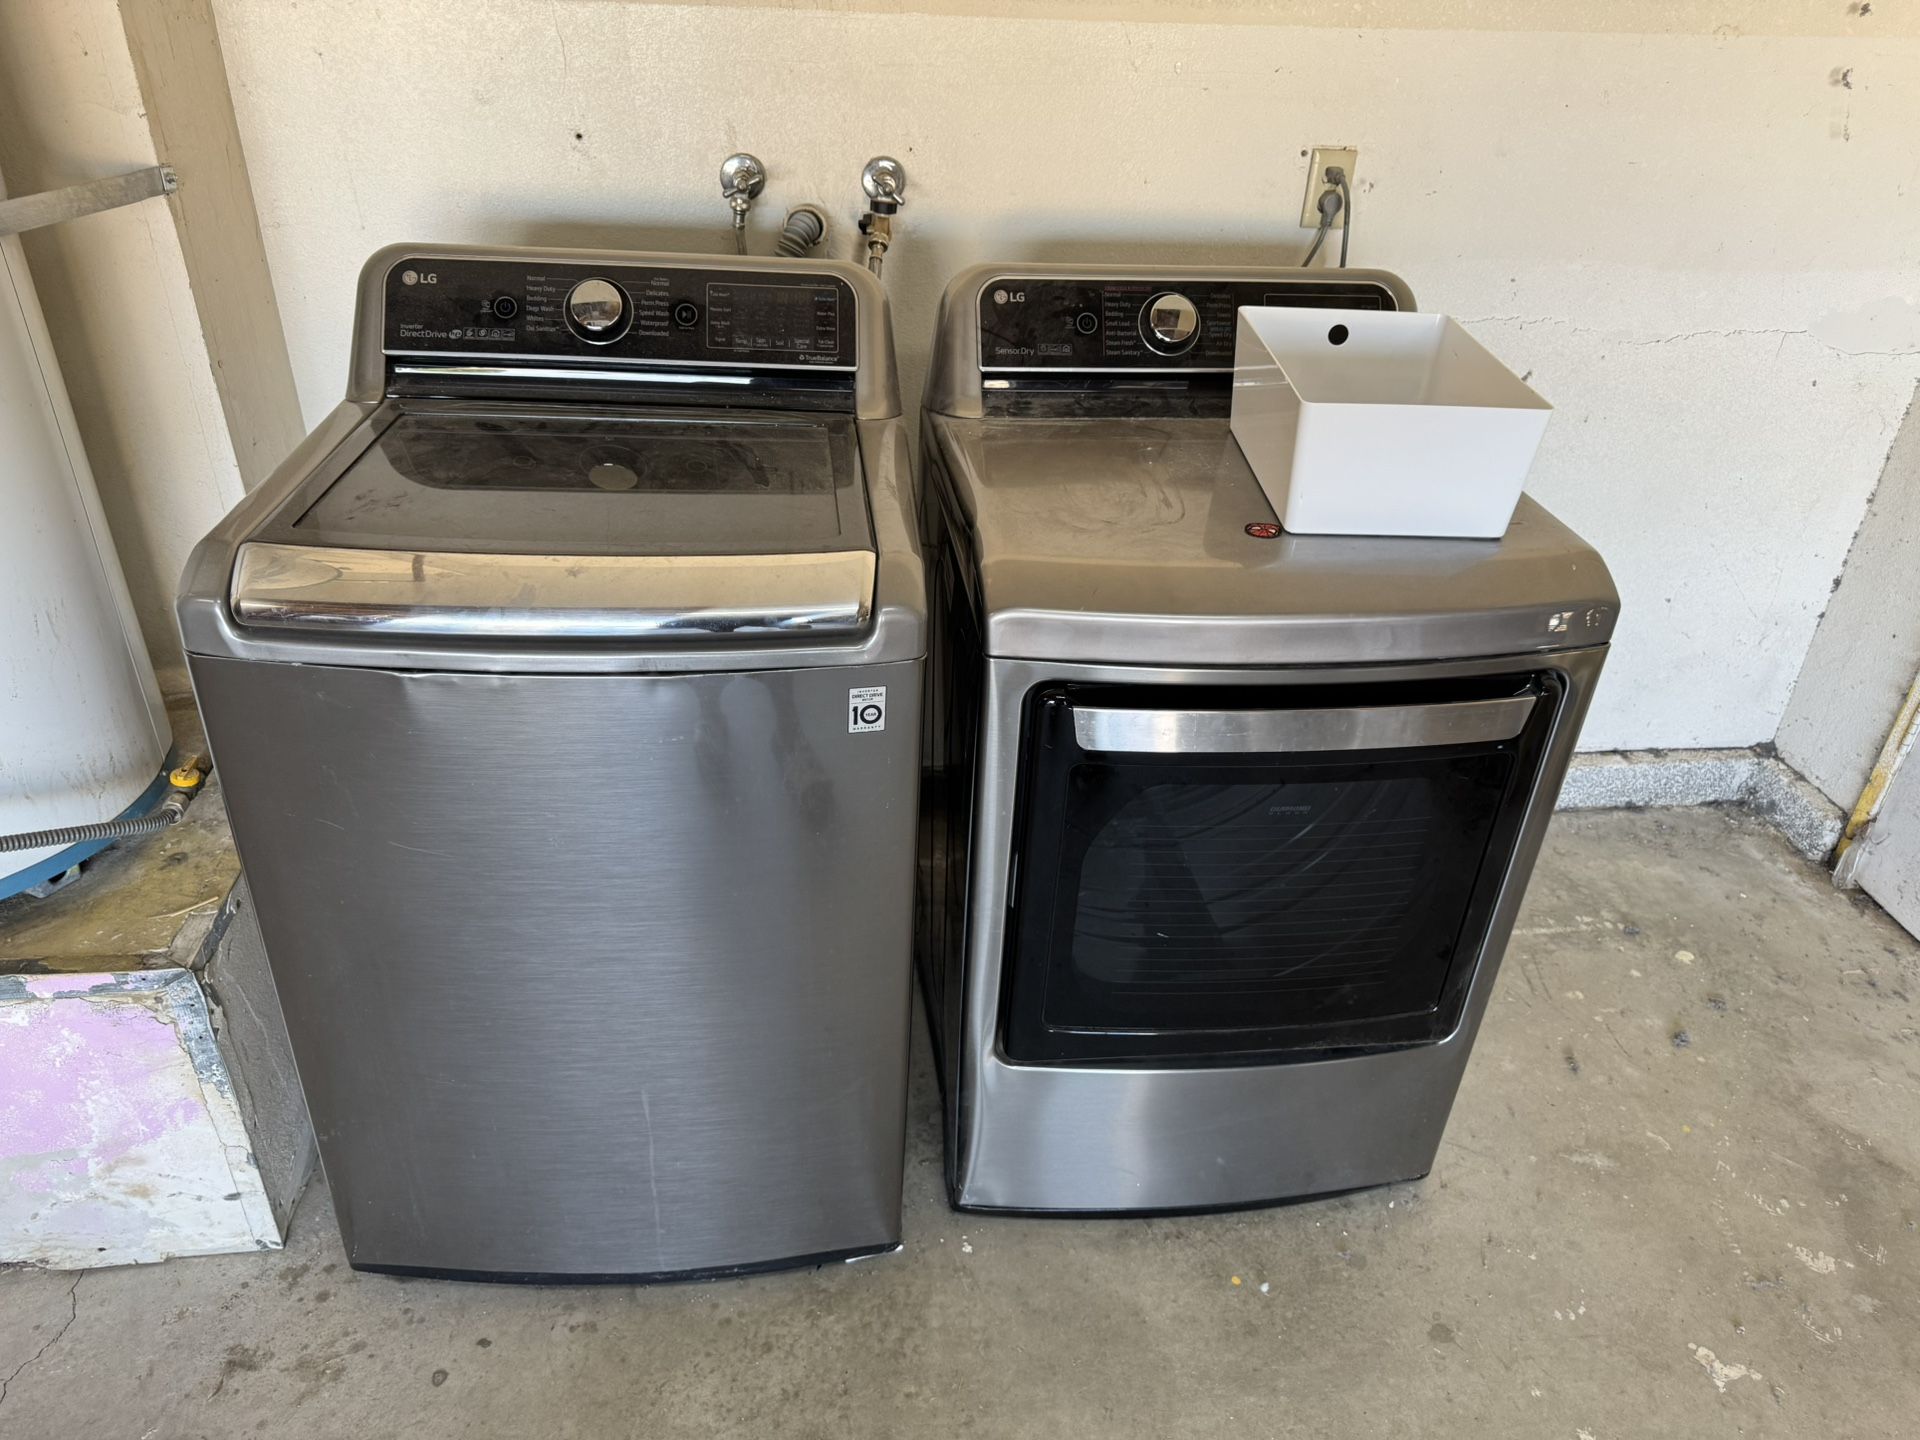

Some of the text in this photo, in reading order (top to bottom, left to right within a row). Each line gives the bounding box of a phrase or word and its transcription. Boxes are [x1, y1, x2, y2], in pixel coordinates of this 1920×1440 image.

[420, 273, 437, 284] LG
[526, 285, 556, 293] Heavy Duty
[526, 295, 547, 303] Bedding
[1010, 292, 1025, 302] LG
[400, 329, 448, 339] DirectDrive
[852, 704, 882, 725] 10
